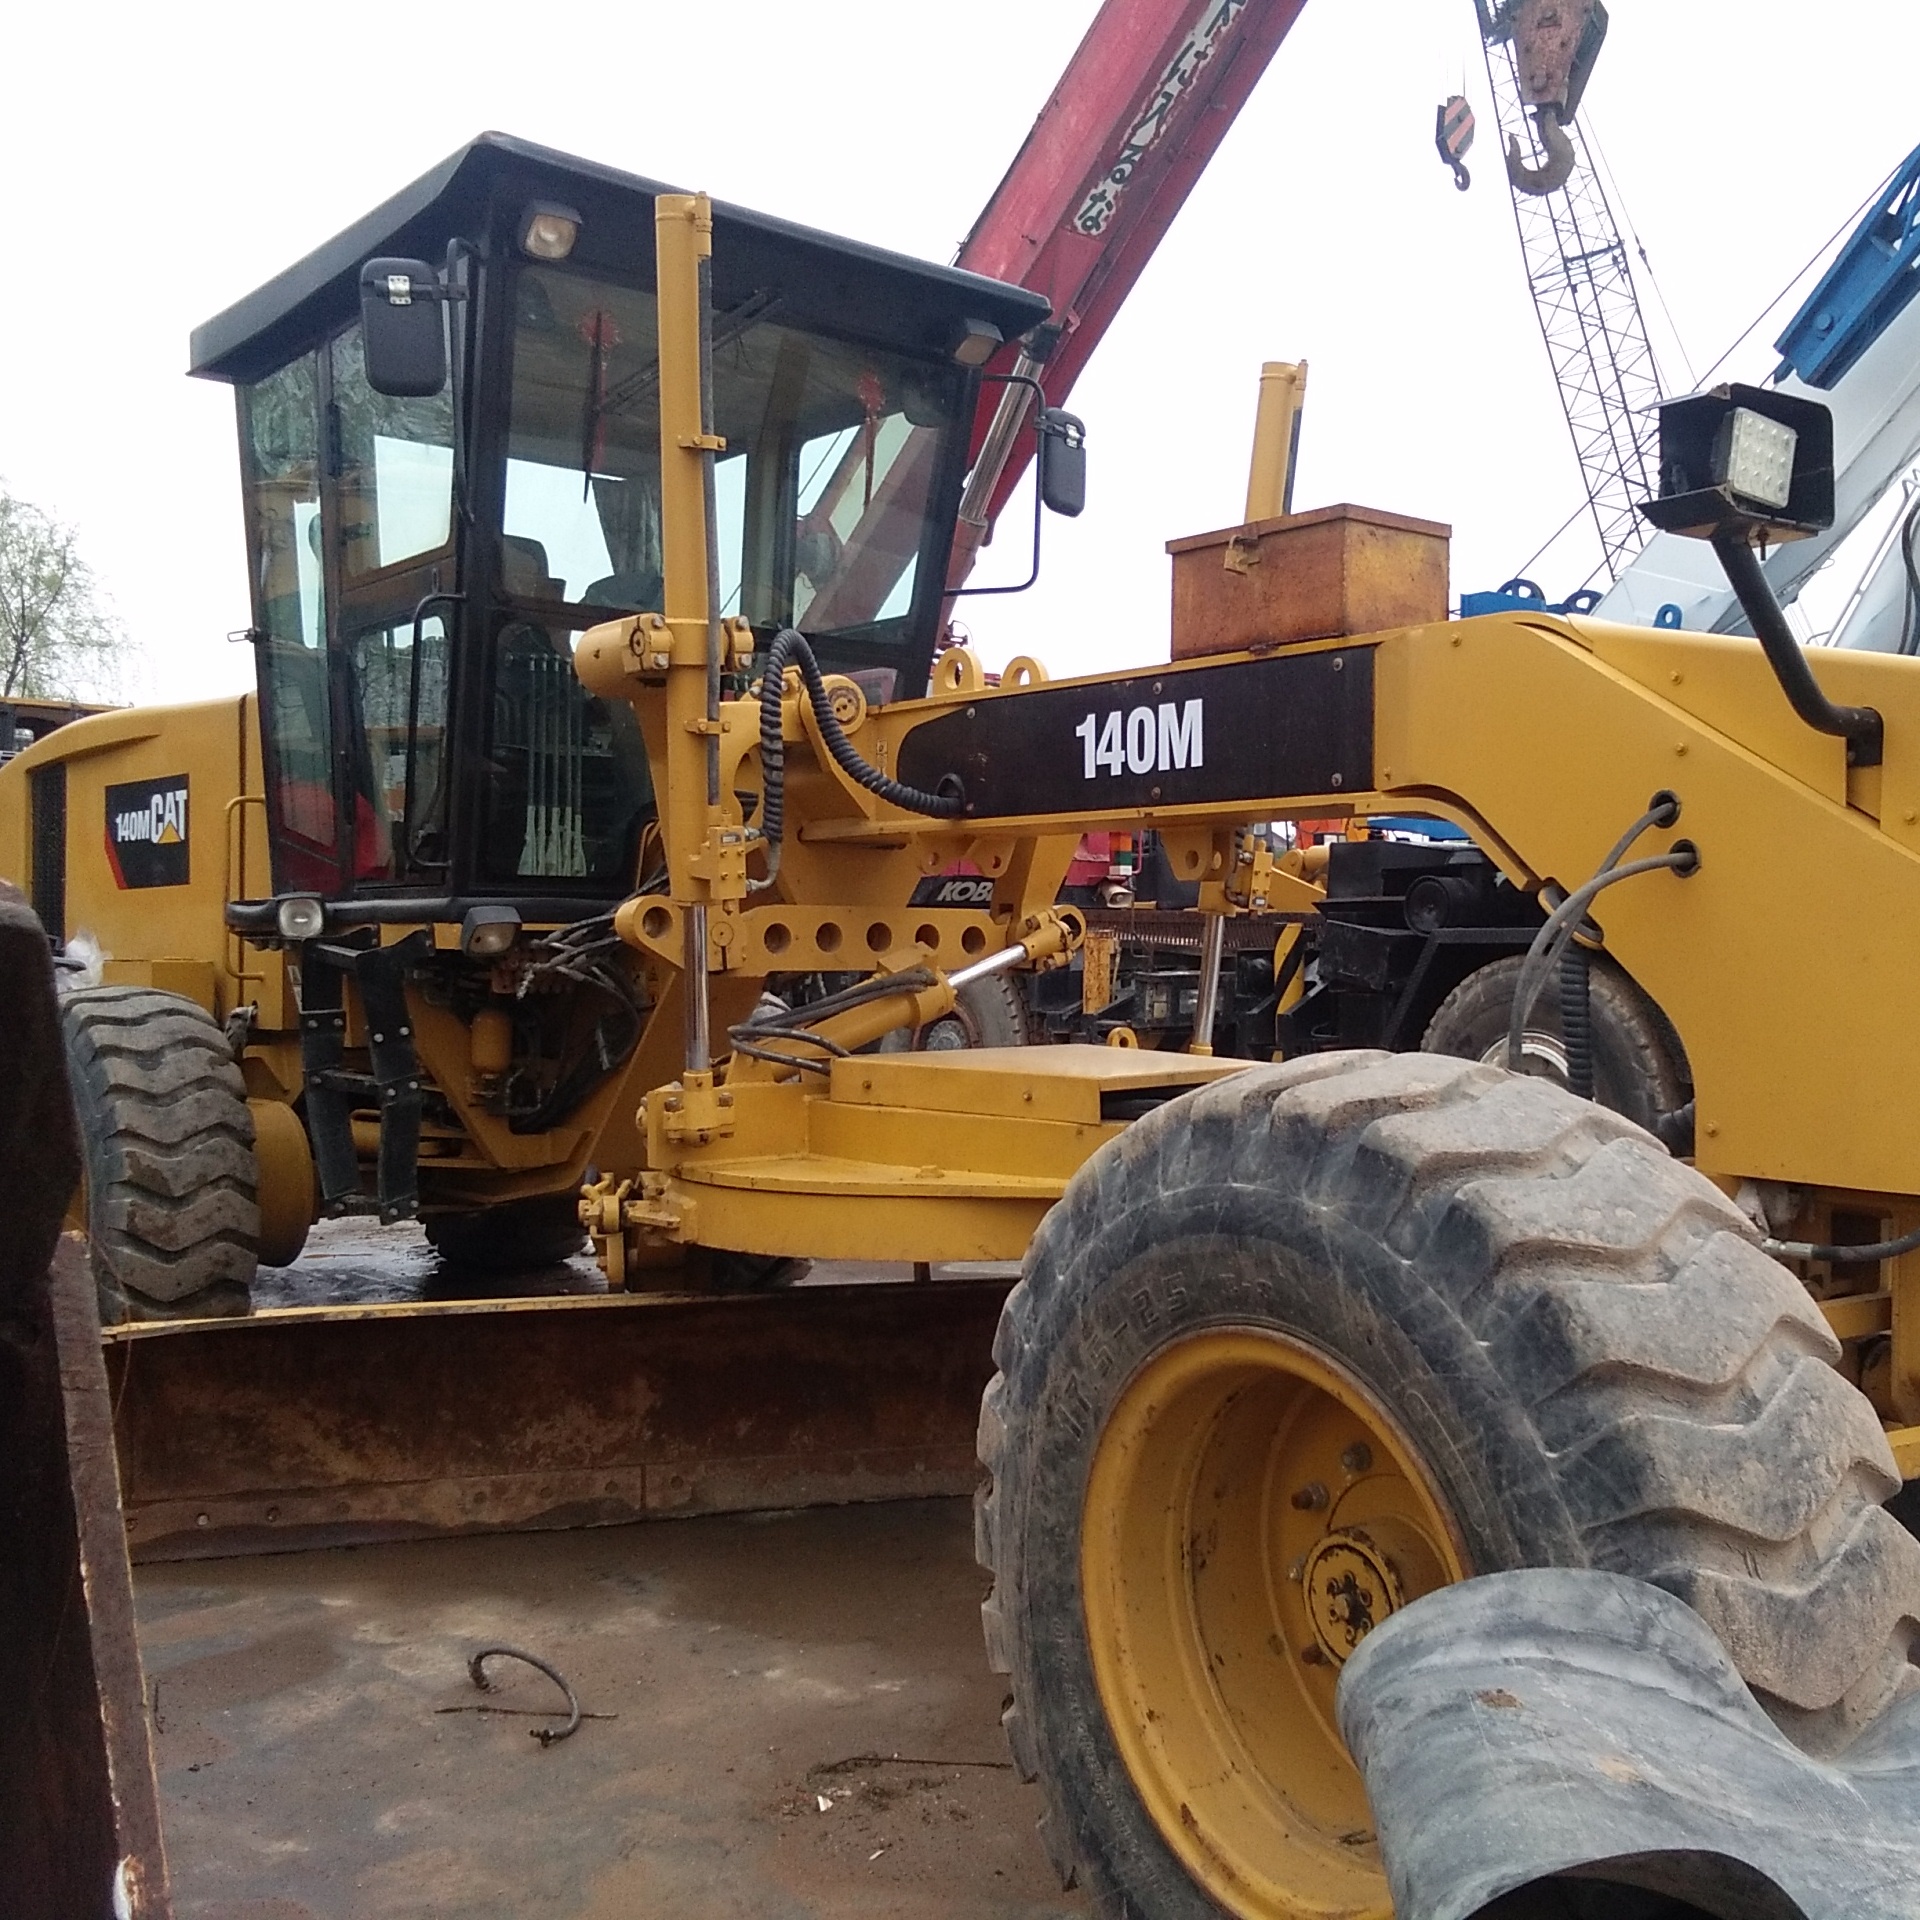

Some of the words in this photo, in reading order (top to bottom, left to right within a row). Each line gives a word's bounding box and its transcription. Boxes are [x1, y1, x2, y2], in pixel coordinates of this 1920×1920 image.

[1075, 698, 1203, 779] 140M
[115, 810, 150, 843] 140M
[150, 789, 188, 844] CAT
